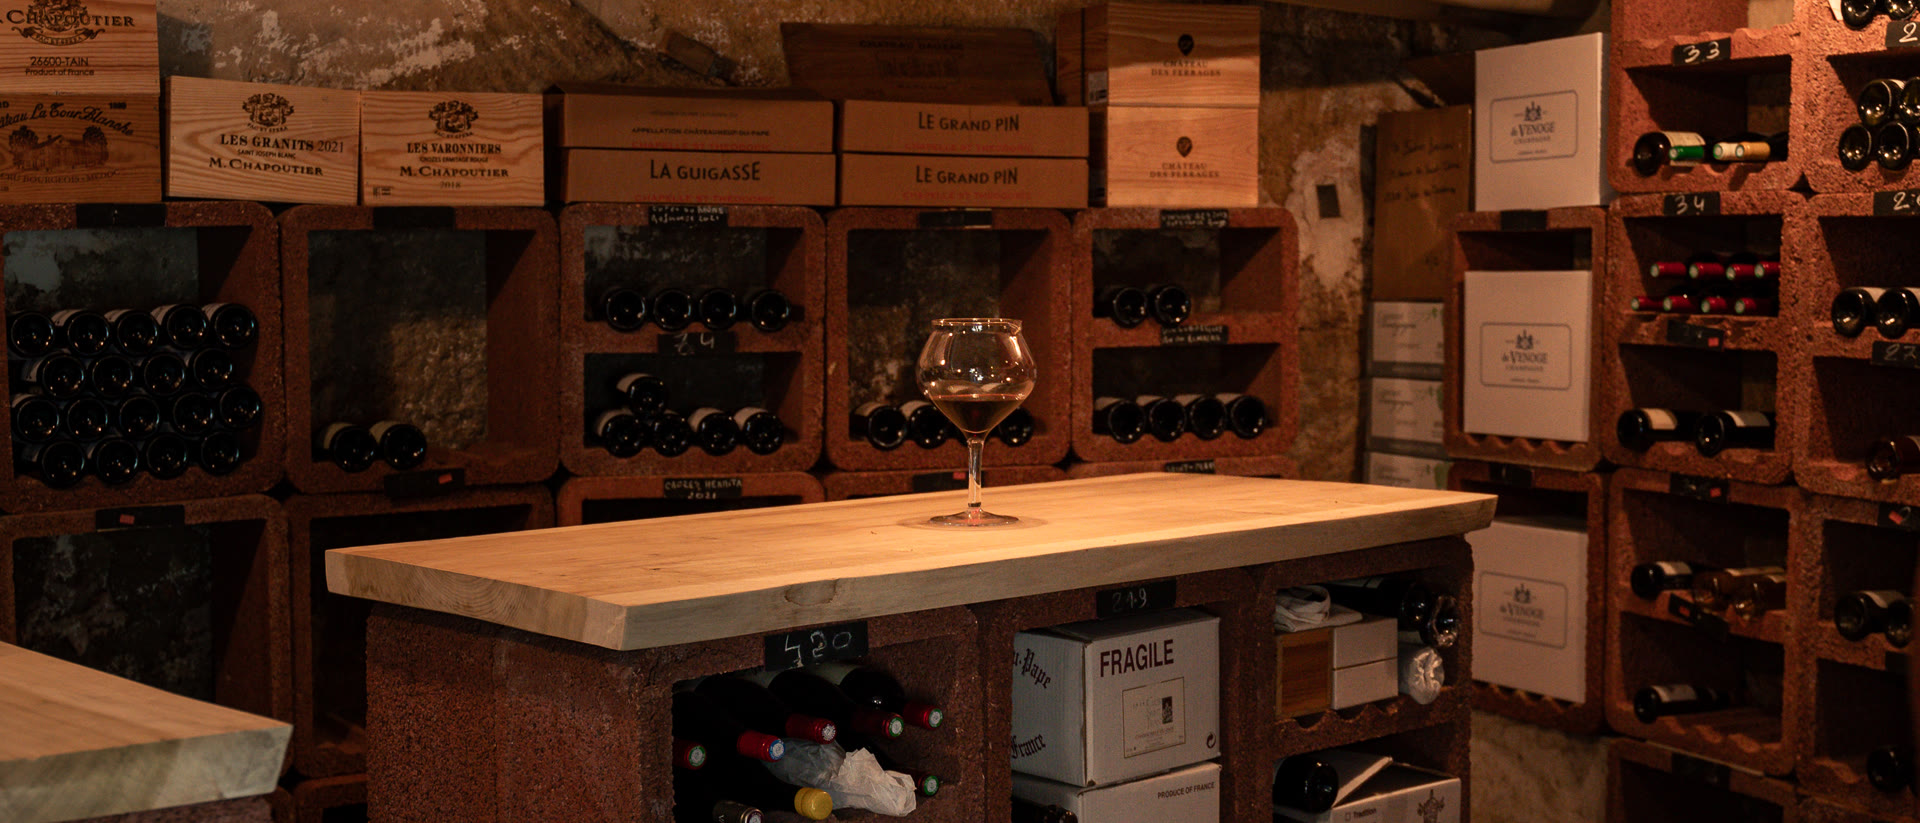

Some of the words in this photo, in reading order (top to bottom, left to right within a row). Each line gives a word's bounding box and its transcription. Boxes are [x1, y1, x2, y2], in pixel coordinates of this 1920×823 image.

[6, 9, 135, 27] CHAPOUTIER
[1683, 41, 1720, 63] 33
[30, 56, 89, 67] 26600-TAIN
[25, 68, 57, 76] Product
[58, 68, 67, 76] of
[67, 68, 95, 76] France
[29, 102, 48, 120] La
[918, 111, 934, 129] LE
[939, 117, 991, 131] GRAND
[996, 114, 1019, 131] PIN
[221, 133, 248, 147] LES
[252, 136, 314, 152] GRANITS
[317, 139, 344, 154] 2021
[407, 142, 428, 154] LES
[431, 143, 502, 155] VARONNIERS
[238, 149, 255, 157] SAINT
[256, 150, 277, 158] JOSEPH
[278, 151, 296, 159] BLANC
[209, 157, 226, 168] M.
[229, 158, 323, 176] CHAPOUTIER
[400, 166, 417, 177] M.
[418, 166, 509, 178] CHAPOUTIER
[650, 159, 672, 179] LA
[677, 161, 761, 181] GUIGASSE
[916, 165, 932, 183] LE
[937, 170, 989, 184] GRAND
[994, 167, 1018, 184] PIN
[1100, 639, 1174, 677] FRAGILE
[1157, 787, 1185, 799] PRODUCE
[1185, 786, 1194, 795] OF
[1193, 782, 1215, 793] FRANCE
